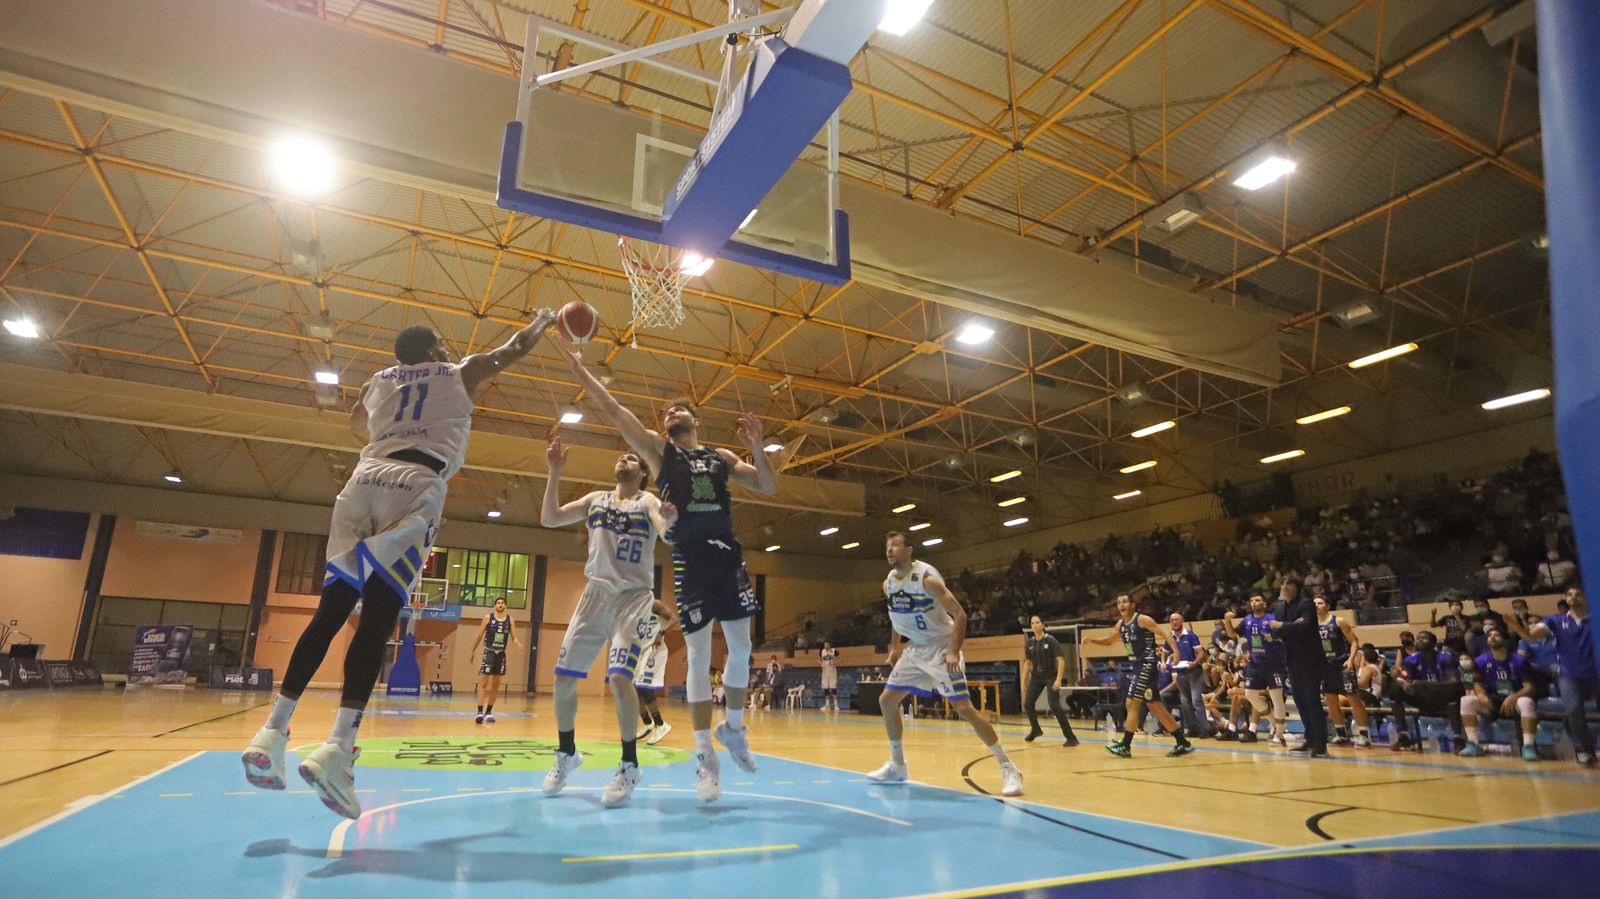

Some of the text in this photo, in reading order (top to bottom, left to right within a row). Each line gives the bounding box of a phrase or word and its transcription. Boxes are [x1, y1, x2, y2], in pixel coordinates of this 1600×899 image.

[394, 383, 429, 422] 11
[616, 538, 643, 563] 26
[738, 588, 754, 606] 35
[497, 625, 504, 633] 2
[914, 614, 928, 630] 6
[1251, 626, 1259, 635] 11
[609, 647, 629, 664] 26
[225, 673, 244, 683] PSOE
